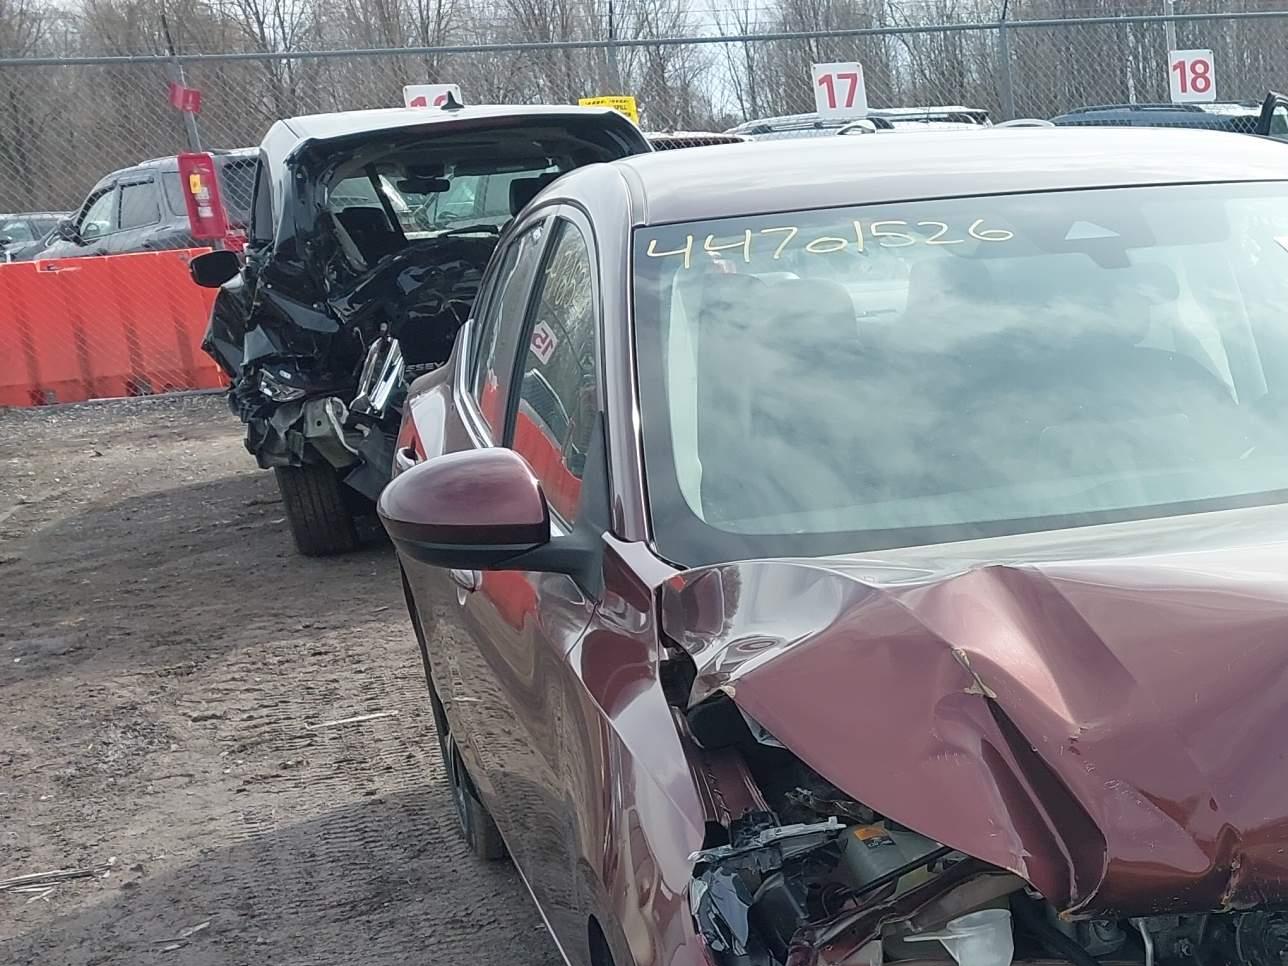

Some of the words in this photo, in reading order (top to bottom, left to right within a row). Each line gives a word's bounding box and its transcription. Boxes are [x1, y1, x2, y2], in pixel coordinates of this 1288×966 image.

[818, 73, 858, 109] 17
[1172, 59, 1211, 93] 18
[646, 219, 1015, 269] 44701526
